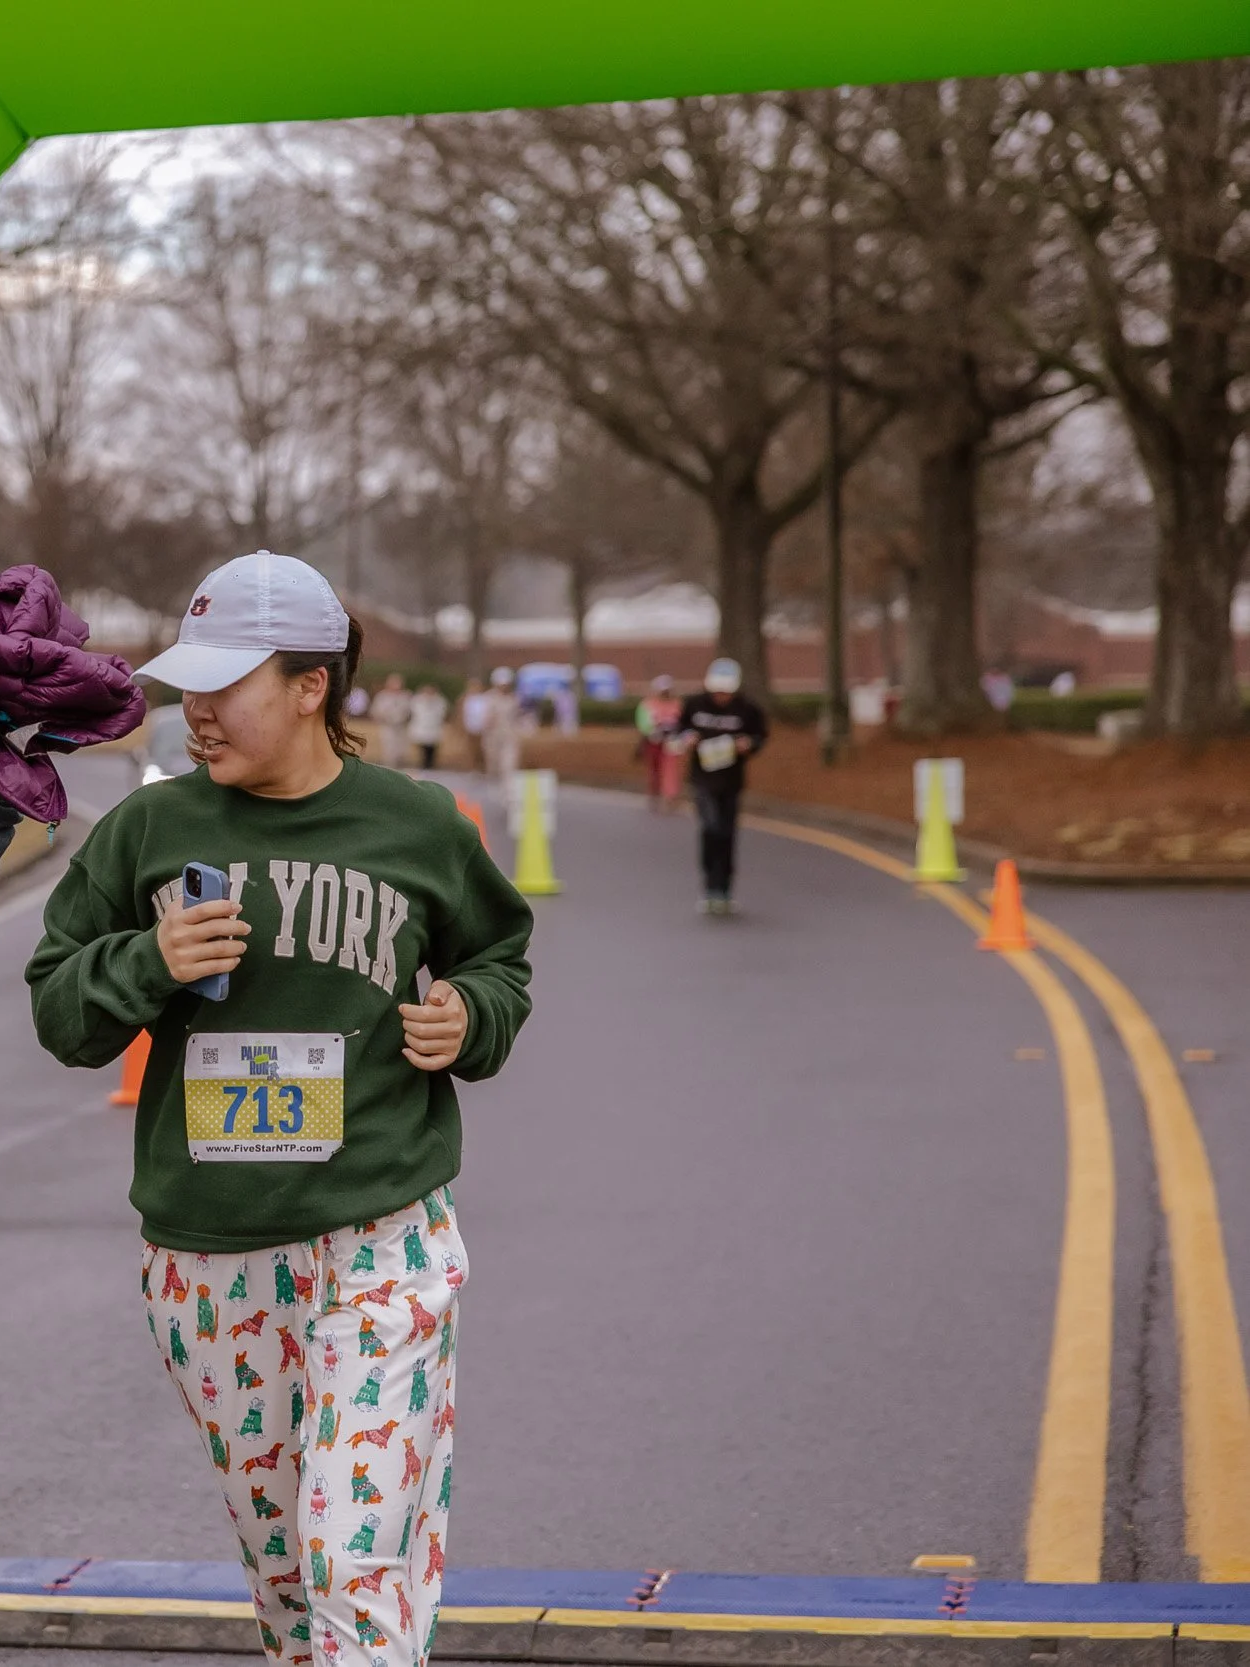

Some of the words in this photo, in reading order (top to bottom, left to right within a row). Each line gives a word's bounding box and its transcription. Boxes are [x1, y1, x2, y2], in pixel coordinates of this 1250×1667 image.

[269, 859, 409, 996] YORK
[222, 1085, 304, 1134] 713
[205, 1143, 323, 1153] www.FiveStarNTP.com
